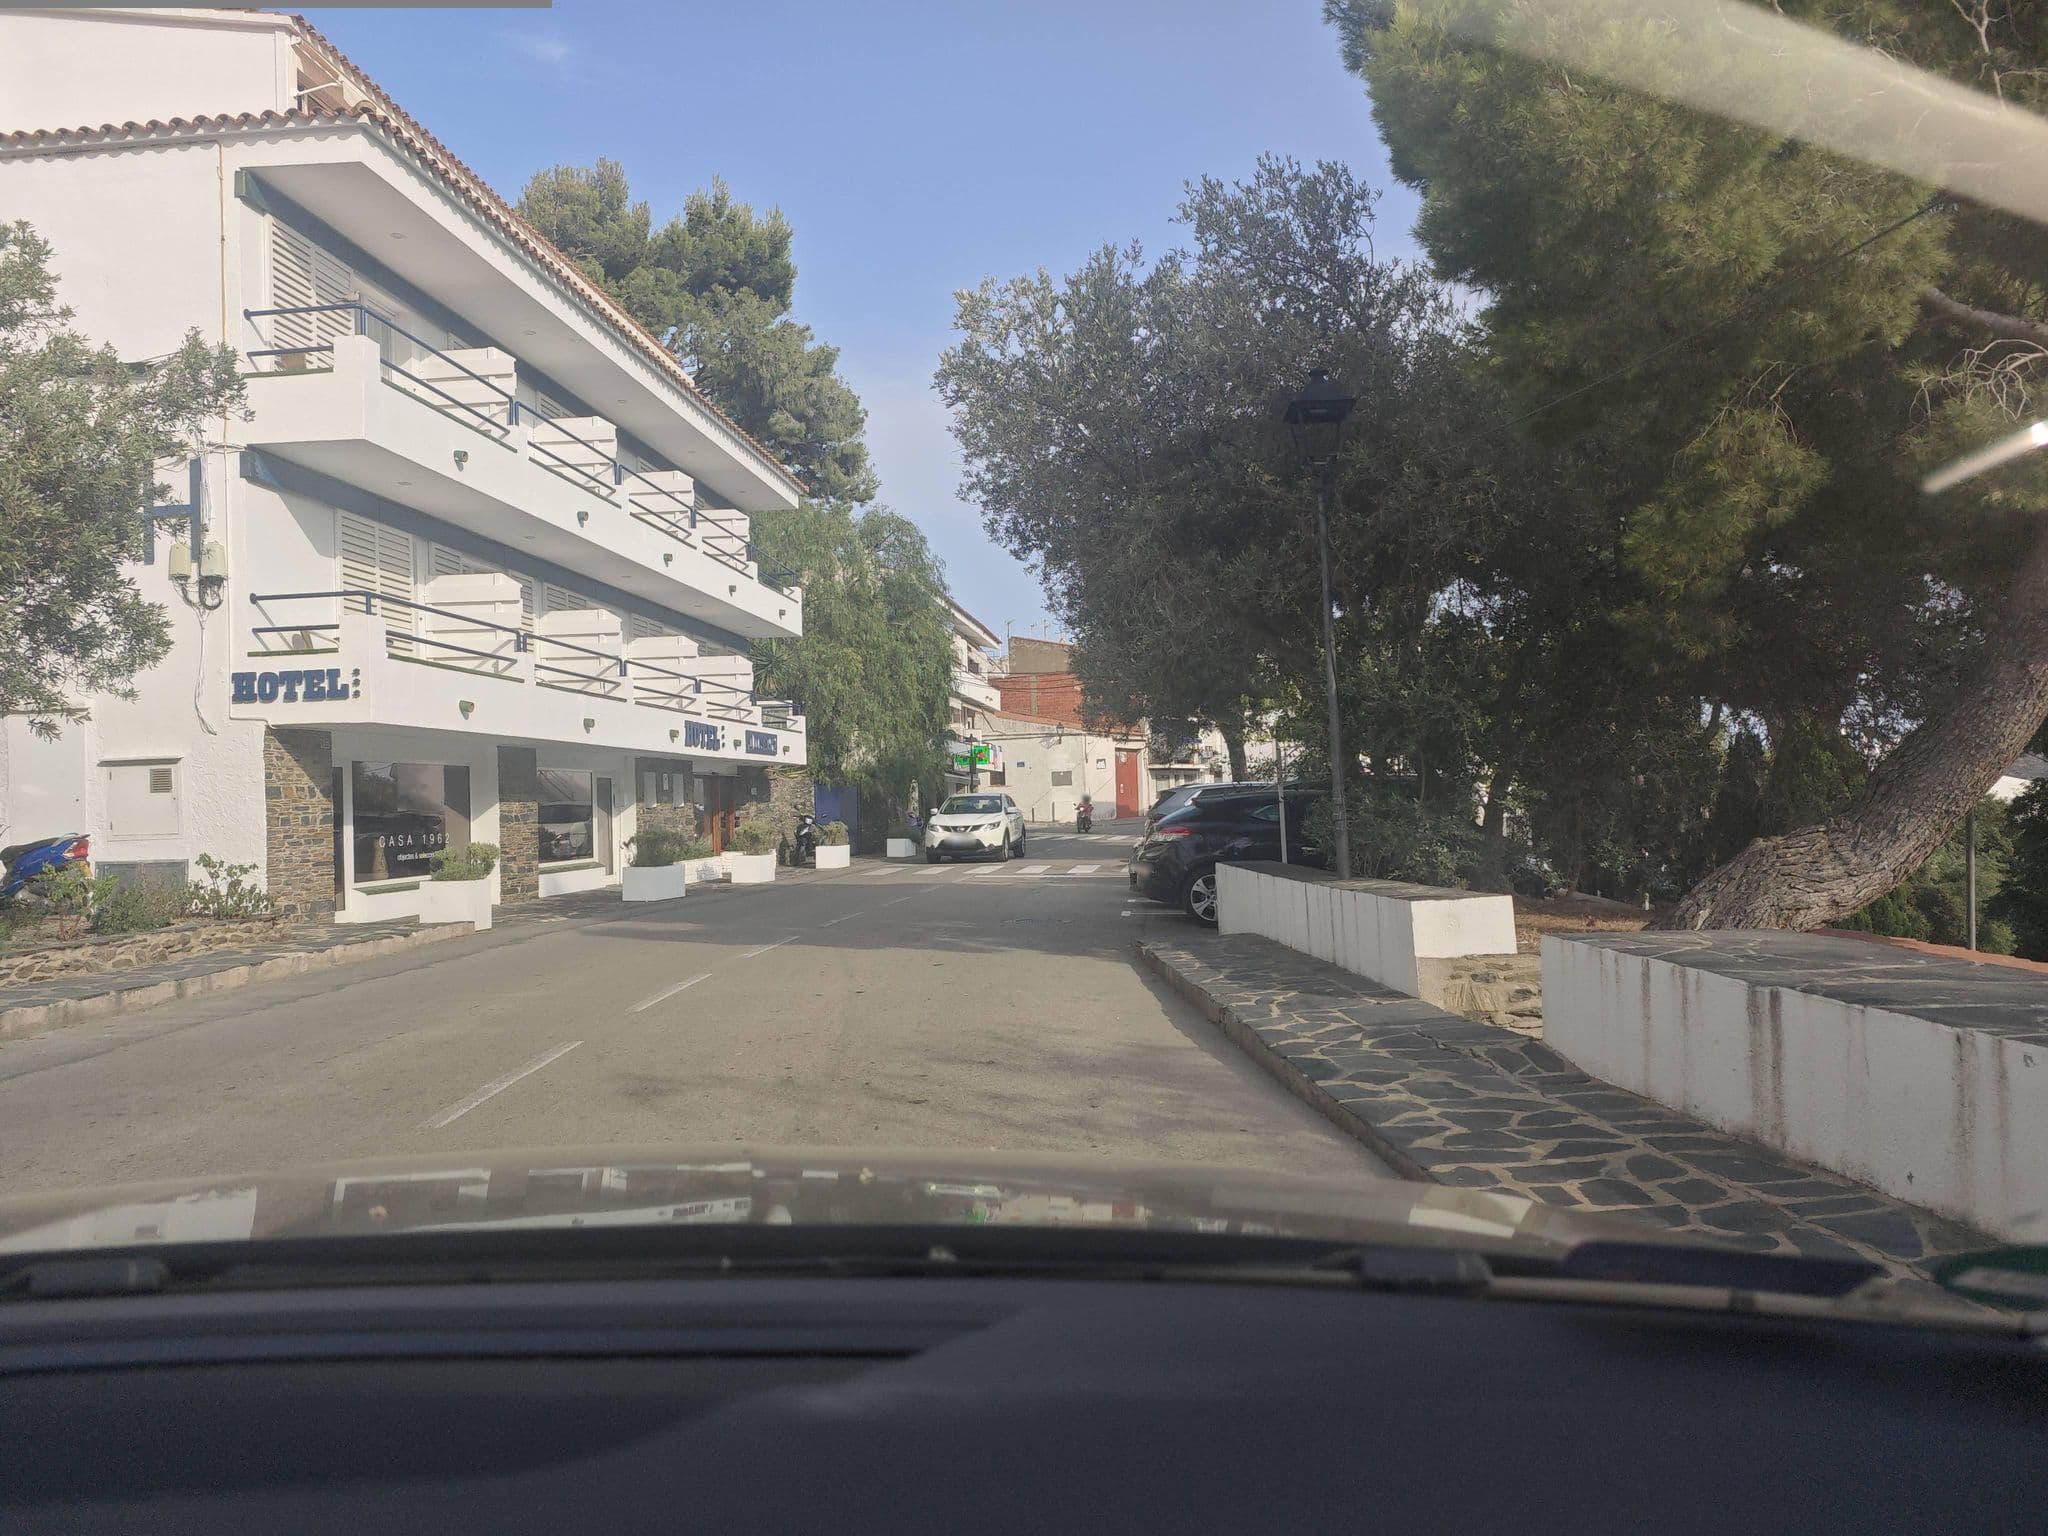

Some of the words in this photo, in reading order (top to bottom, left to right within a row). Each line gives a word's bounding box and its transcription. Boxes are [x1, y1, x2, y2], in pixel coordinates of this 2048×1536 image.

[231, 668, 350, 704] HOTEL
[684, 720, 721, 751] HOTEL
[380, 834, 414, 848] CASA
[422, 832, 451, 845] 1962
